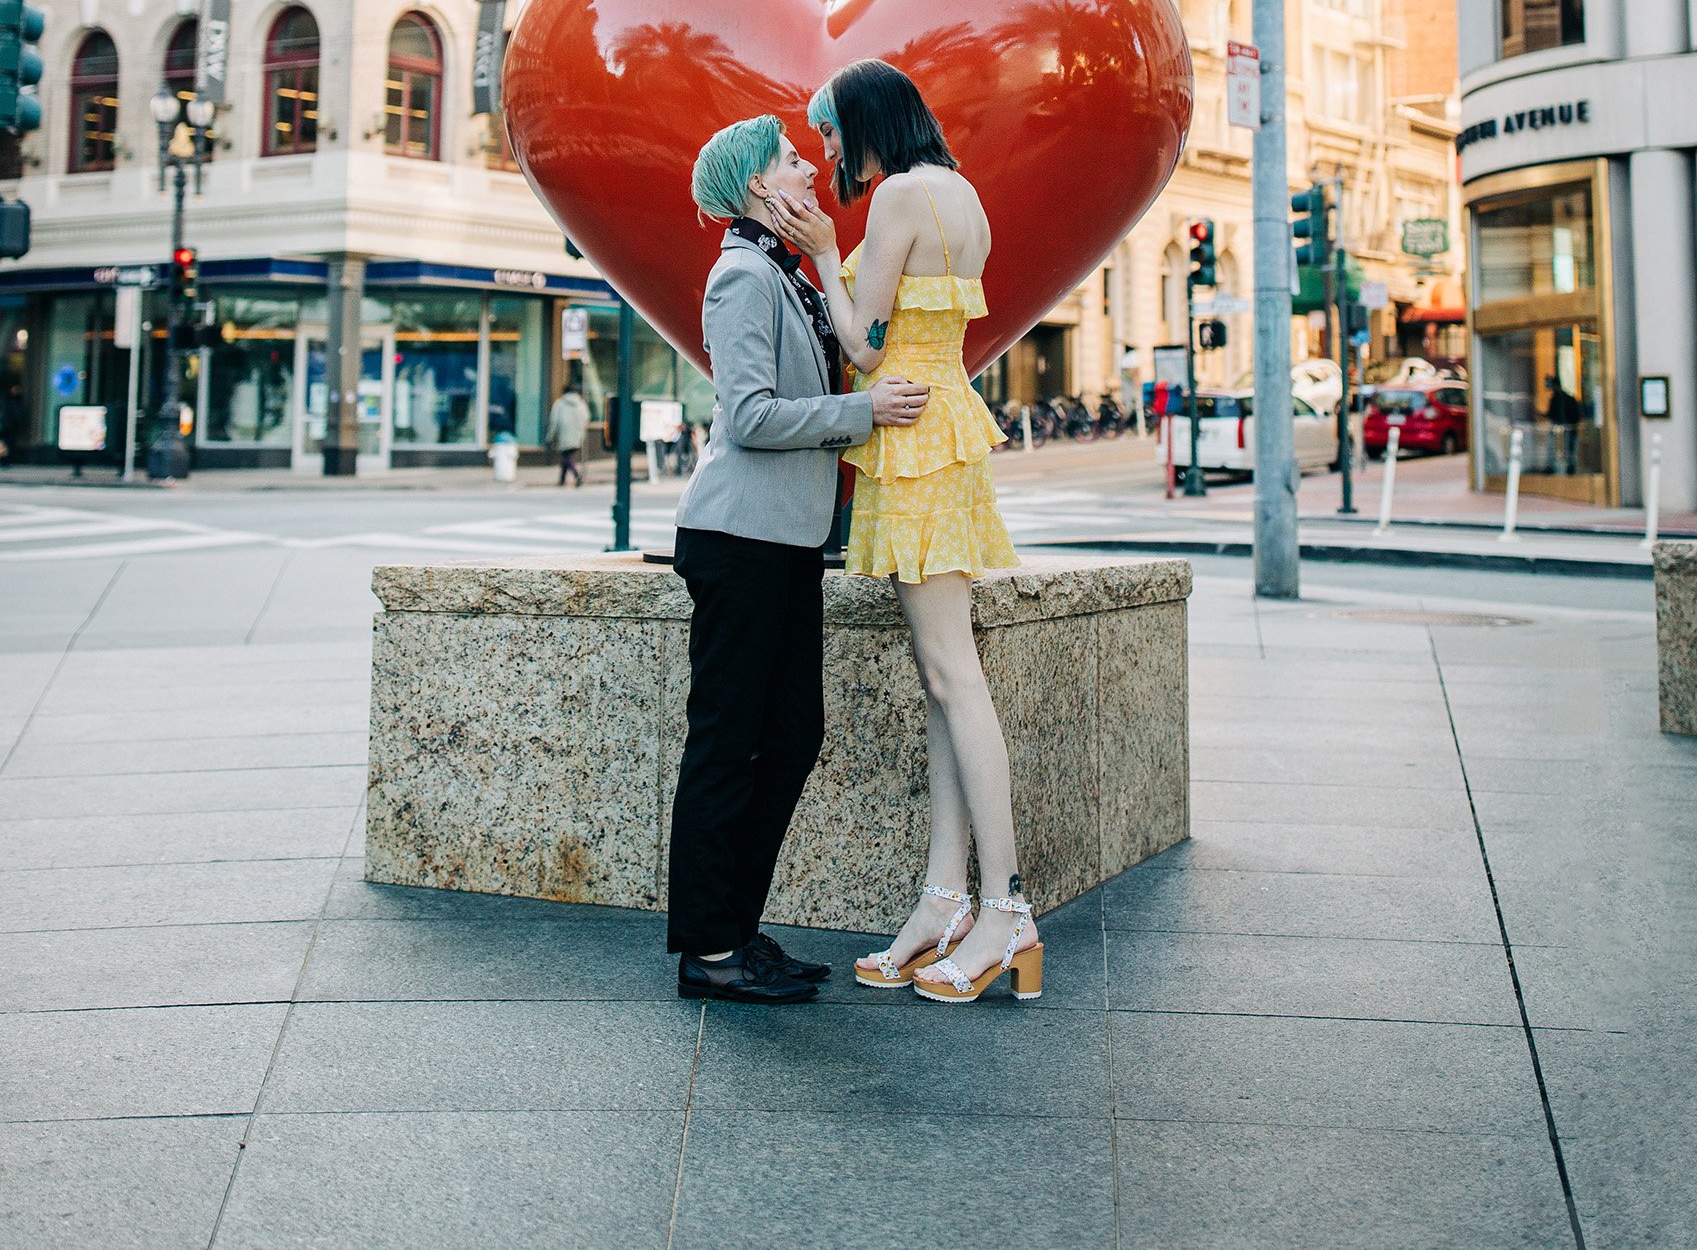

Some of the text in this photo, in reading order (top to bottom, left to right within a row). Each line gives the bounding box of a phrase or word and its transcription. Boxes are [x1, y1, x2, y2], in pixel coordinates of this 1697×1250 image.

[206, 20, 227, 82] DSW
[473, 29, 492, 88] DSW
[1503, 99, 1590, 134] AVENUE
